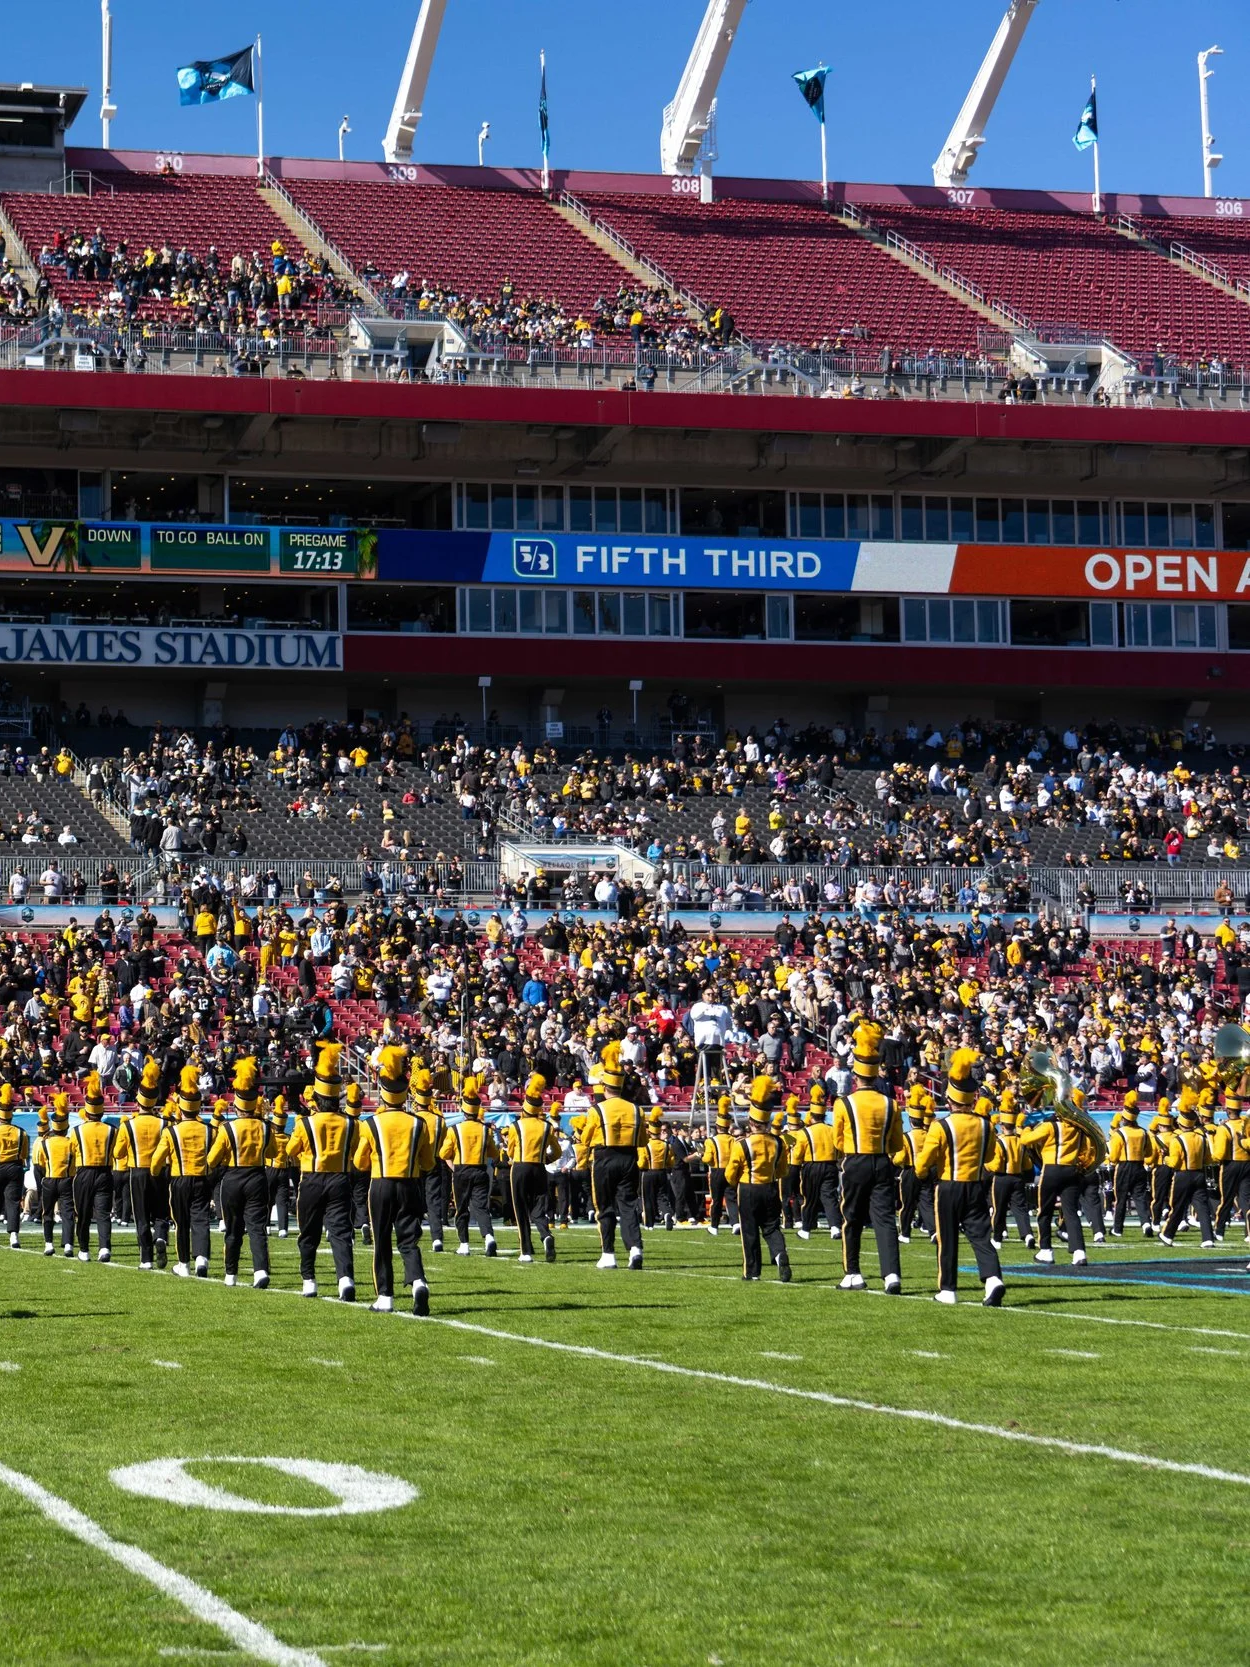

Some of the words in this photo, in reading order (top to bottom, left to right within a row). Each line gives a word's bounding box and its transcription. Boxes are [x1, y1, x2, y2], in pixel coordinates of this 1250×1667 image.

[389, 165, 418, 181] 309
[671, 178, 700, 193] 308
[947, 189, 975, 204] 307
[1215, 201, 1243, 216] 306
[88, 529, 131, 542] DOWN
[157, 530, 174, 544] TO
[178, 531, 197, 545] GO
[206, 532, 240, 546] BALL
[244, 533, 264, 546] ON
[289, 533, 347, 548] PREGAME
[293, 551, 343, 570] 17:13
[576, 545, 686, 575] FIFTH
[703, 549, 822, 578] THIRD
[1084, 553, 1218, 593] OPEN
[153, 630, 341, 669] STADIUM
[197, 998, 210, 1011] 12
